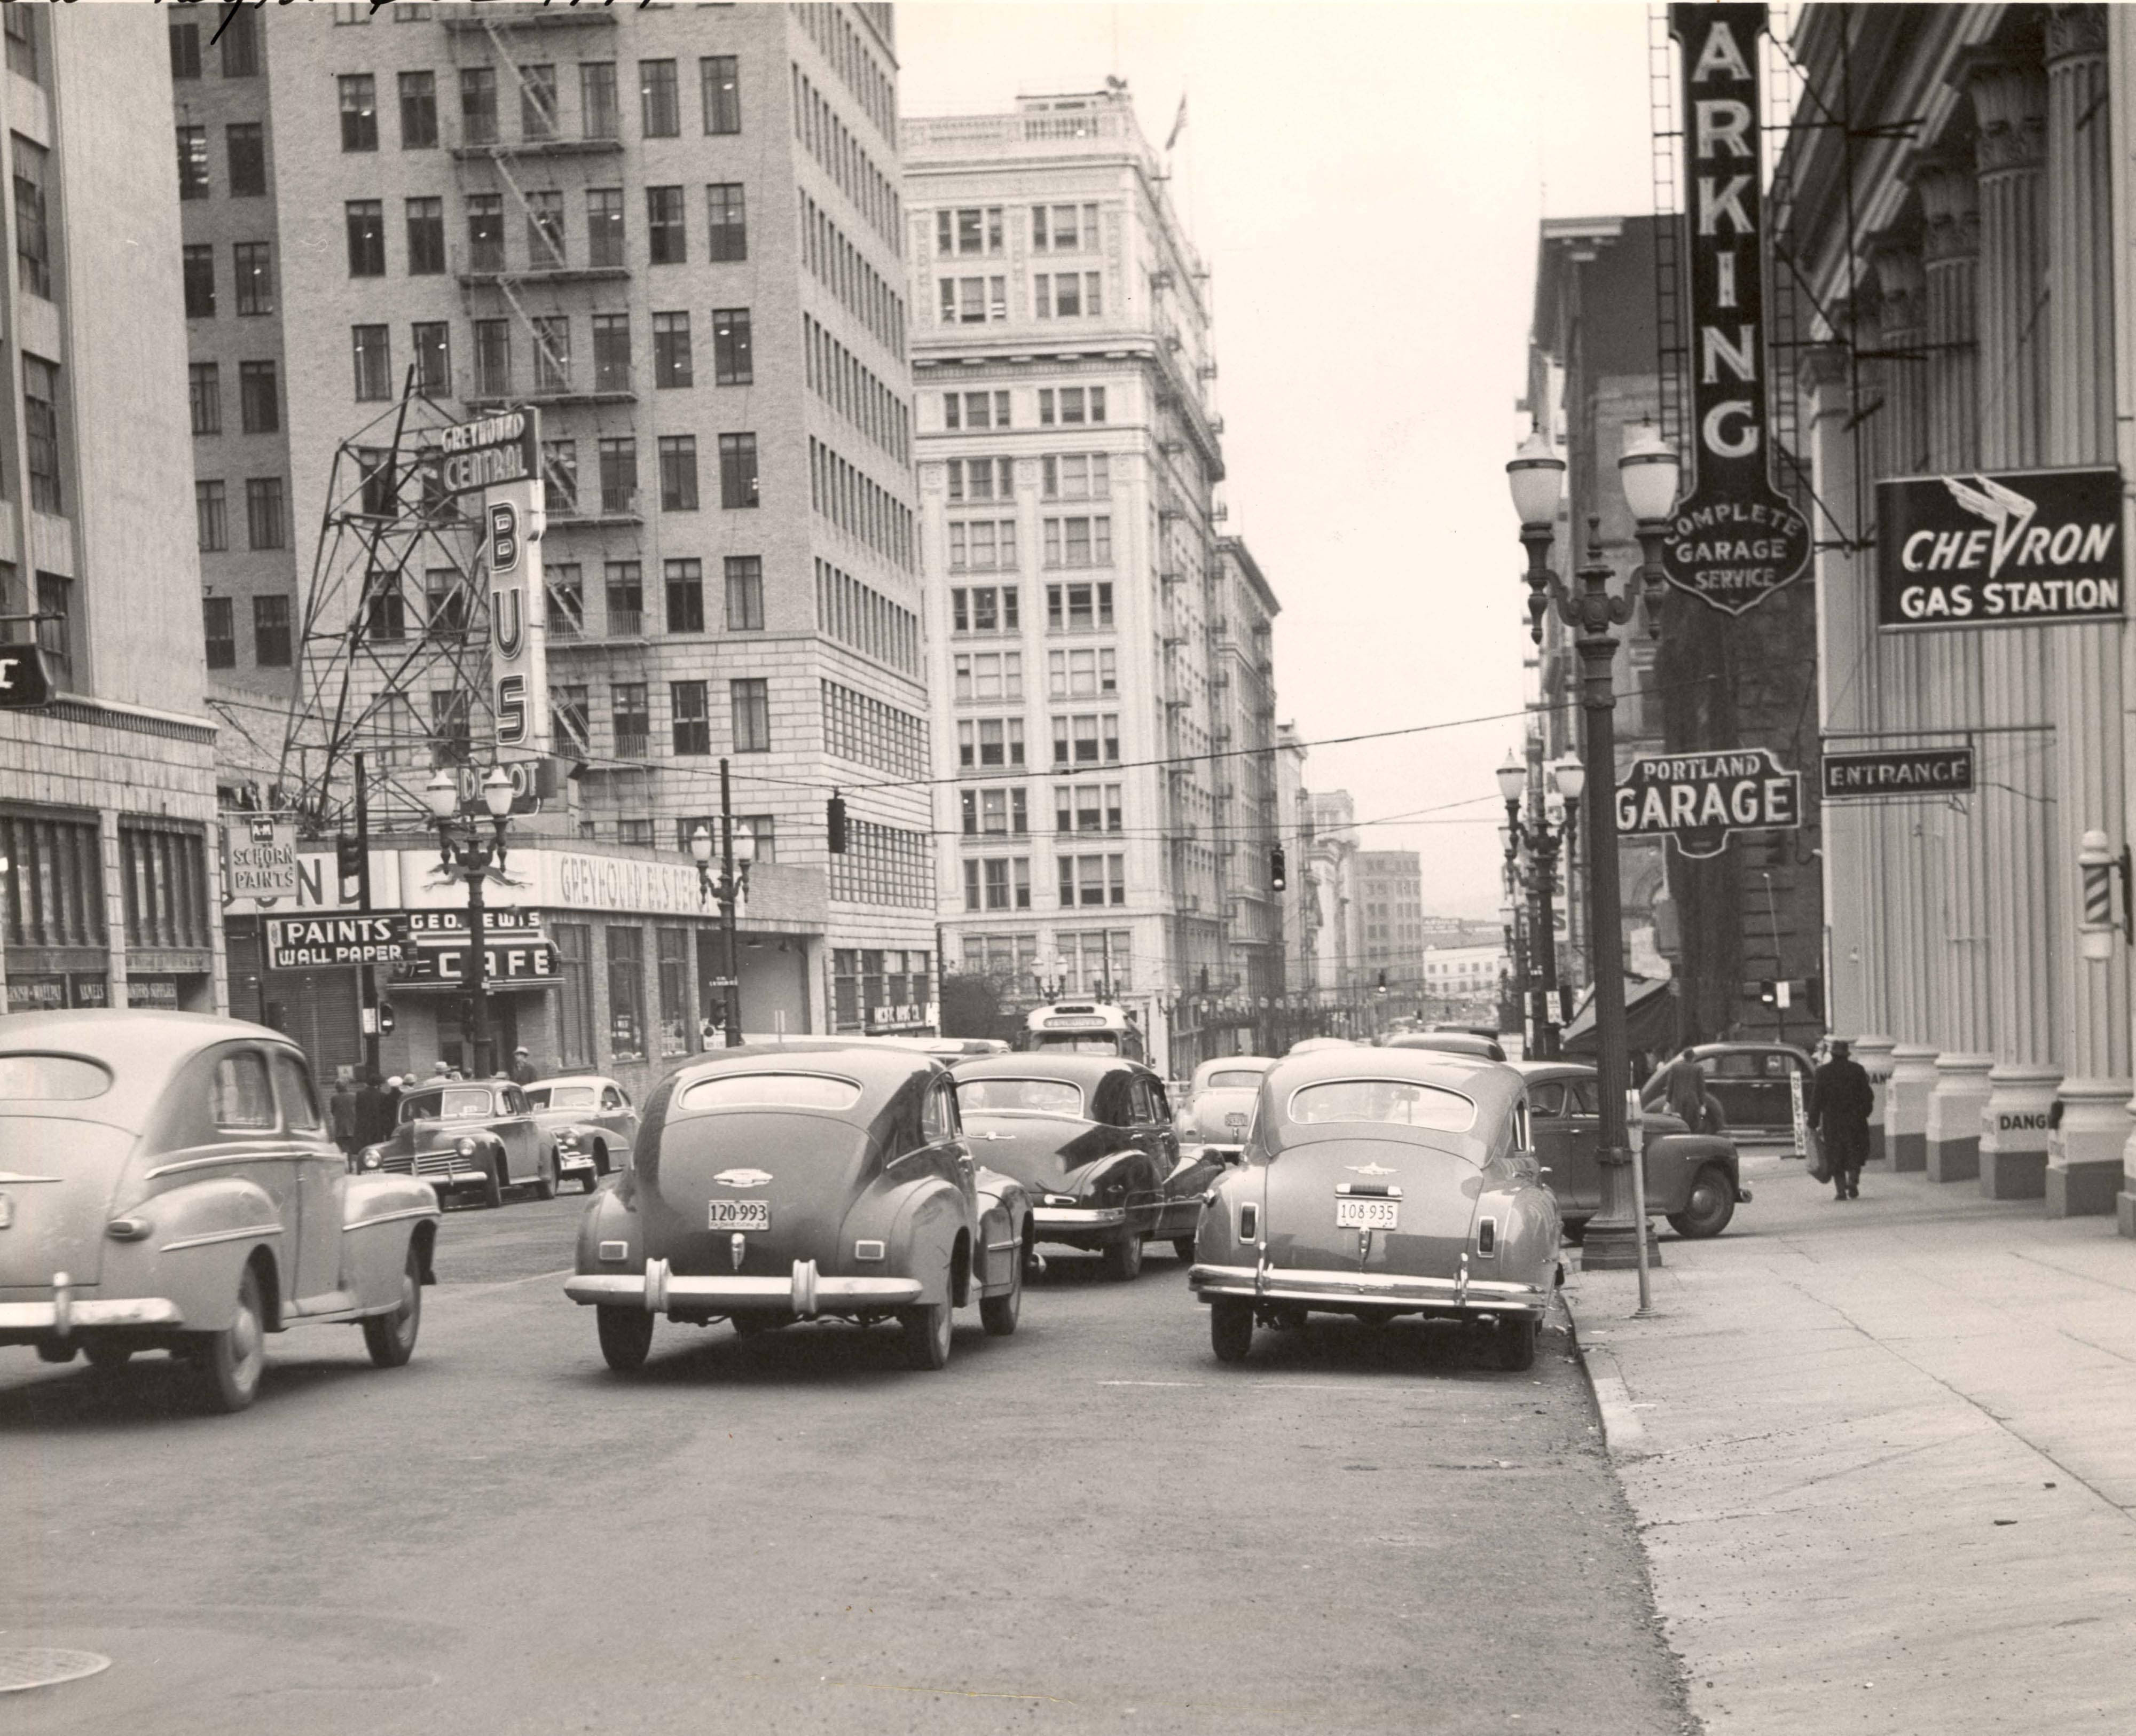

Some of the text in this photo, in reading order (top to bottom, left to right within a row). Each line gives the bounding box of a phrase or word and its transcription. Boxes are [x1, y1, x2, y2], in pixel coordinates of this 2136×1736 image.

[442, 413, 524, 453] GREYHOUND
[444, 444, 528, 491] CENTRAL
[1676, 540, 1786, 563] GARAGE
[1902, 500, 2116, 579] CHEVRON
[1695, 568, 1776, 590] SERVICE
[1901, 578, 2119, 618] GAS STATION
[488, 500, 529, 746] BUS
[460, 762, 539, 801] DEOT
[1643, 755, 1761, 782] PORTLAND
[1830, 758, 1967, 786] ENTRANCE
[1615, 777, 1792, 830] GARAGE
[235, 869, 293, 889] PAINTS
[287, 918, 391, 945] PAINTS
[410, 912, 540, 929] GEO. EWIS
[278, 945, 403, 965] WALL PAPER
[711, 1204, 767, 1221] 120-993
